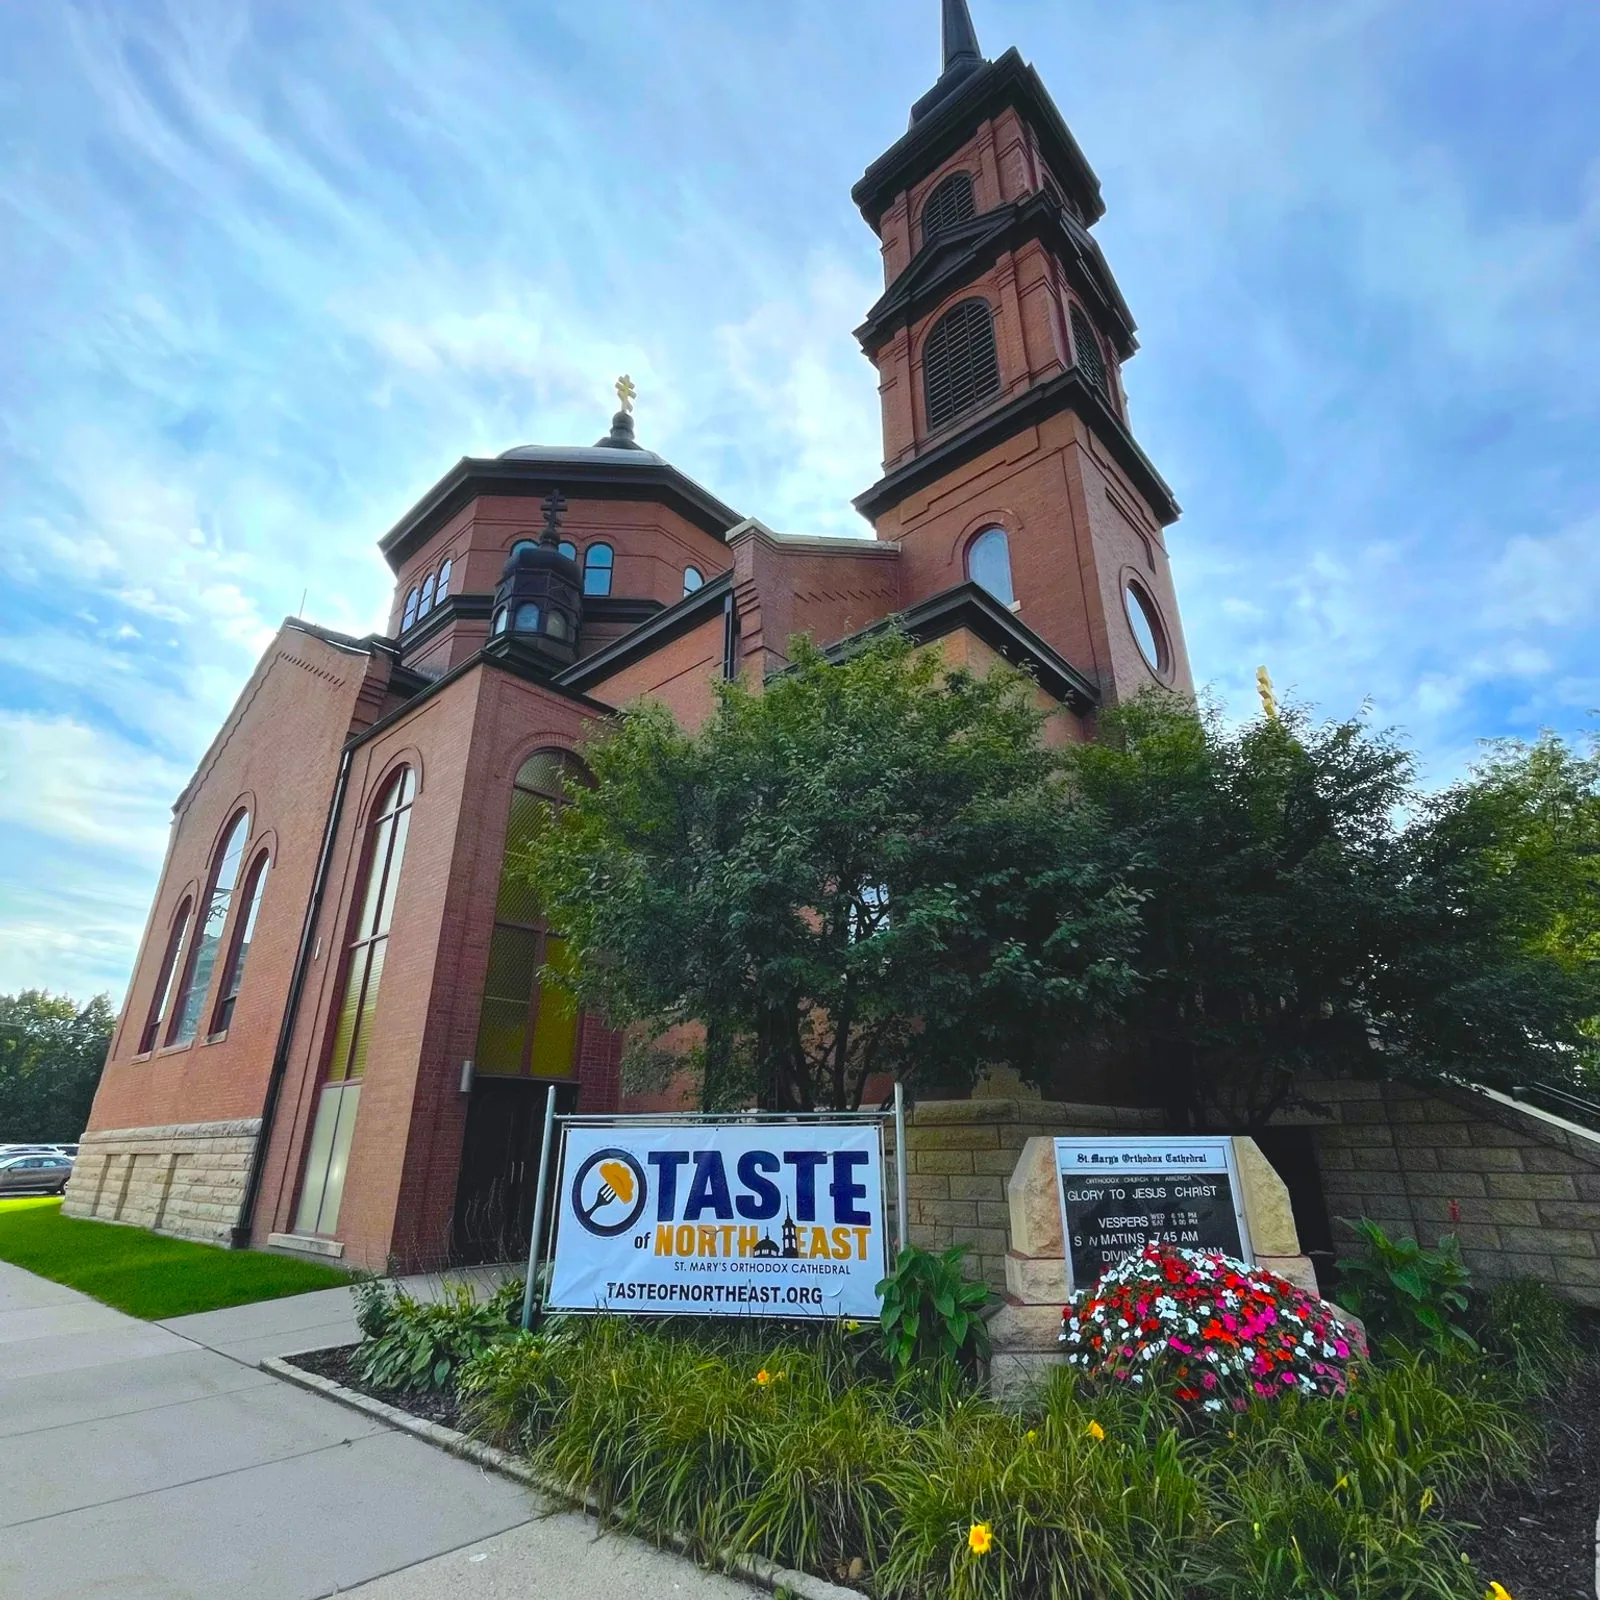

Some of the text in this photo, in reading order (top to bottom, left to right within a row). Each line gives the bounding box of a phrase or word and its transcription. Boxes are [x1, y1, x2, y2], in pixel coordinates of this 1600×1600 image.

[1077, 1153, 1207, 1165] St. Mary's Orthodox Cathedral
[1086, 1177, 1119, 1185] ORTHODOX
[648, 1151, 871, 1226] TASTE
[1067, 1185, 1217, 1201] GLORY TO JESUS CHRIST
[1098, 1216, 1149, 1228] VESPERS
[634, 1231, 650, 1249] of
[1100, 1232, 1145, 1245] MATINS
[1181, 1231, 1199, 1242] AM
[1102, 1250, 1133, 1262] DIVIN
[674, 1261, 851, 1275] ST. MARY'S ORTHODOX CATHEDRAL
[606, 1282, 823, 1304] TASTEOFNORTHEAST.ORG
